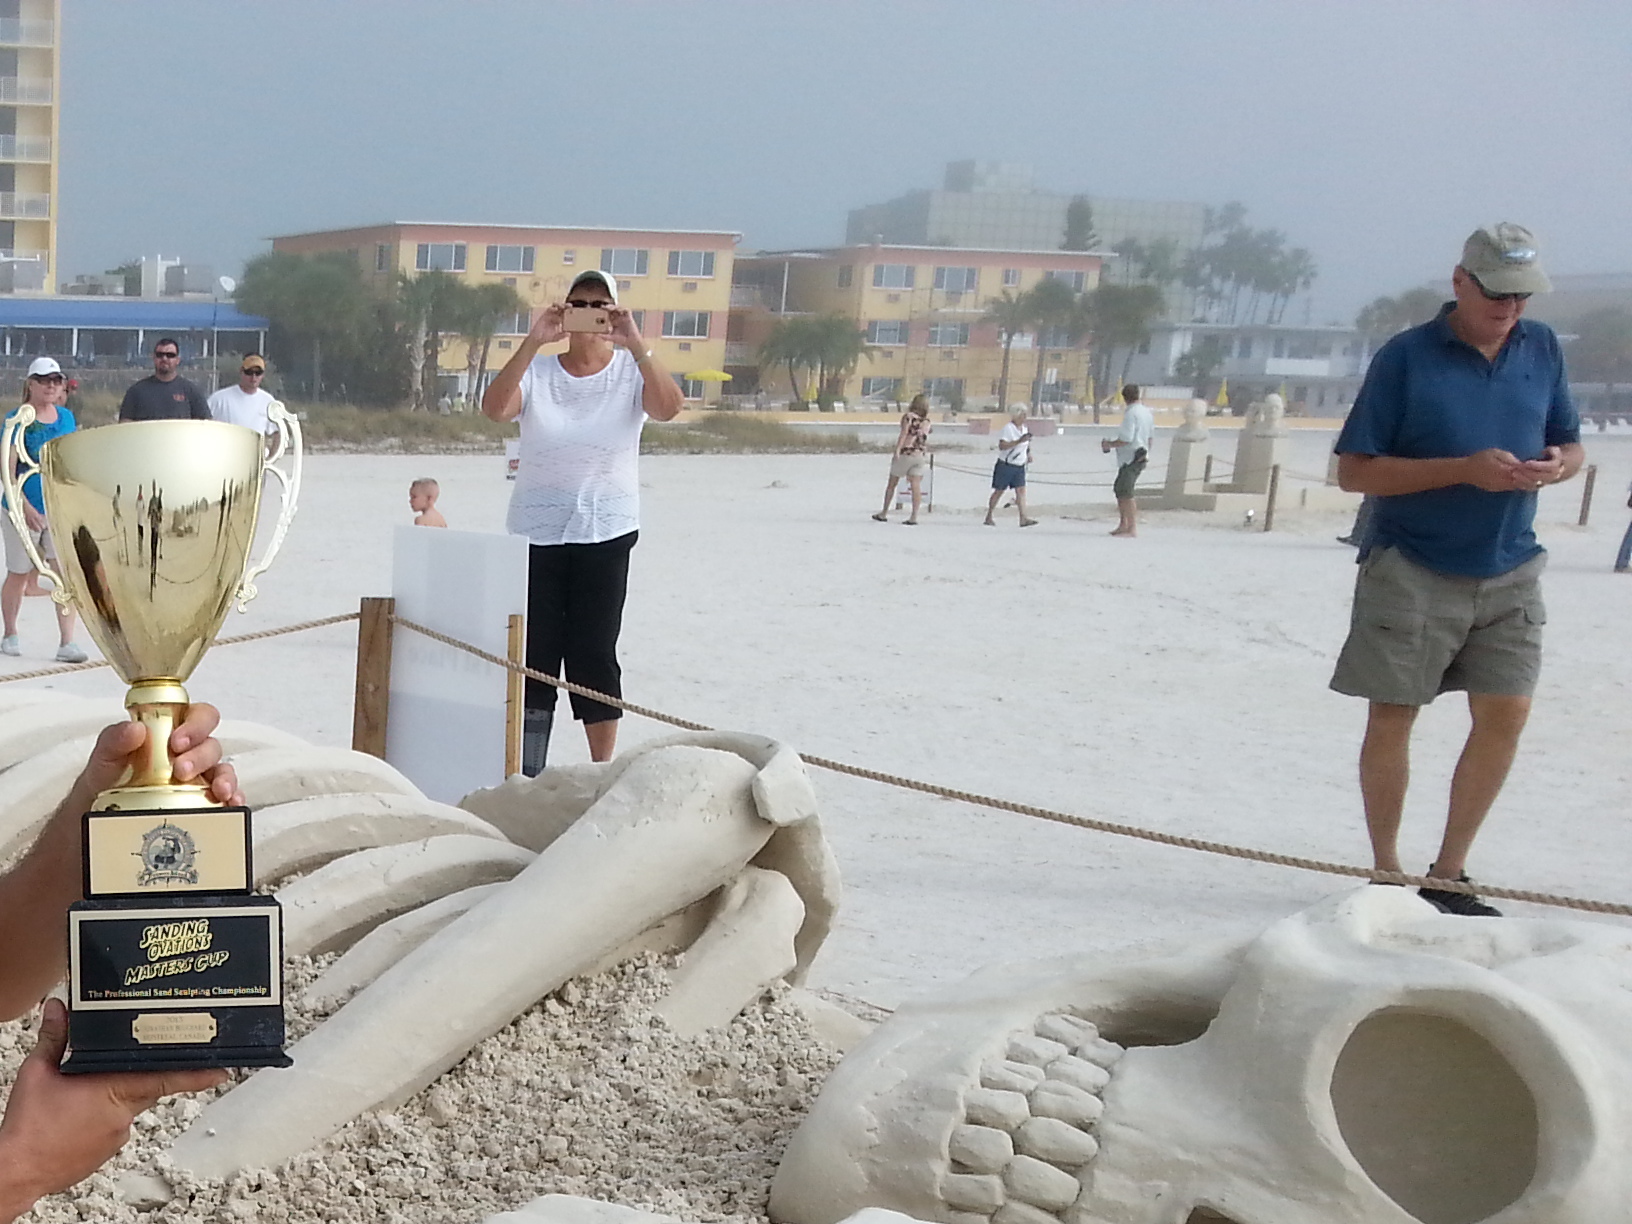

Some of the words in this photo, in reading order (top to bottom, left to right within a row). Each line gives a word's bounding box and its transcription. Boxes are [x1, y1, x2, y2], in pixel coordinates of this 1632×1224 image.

[139, 918, 209, 949] SANDING
[148, 932, 212, 961] OVATIONS
[124, 957, 194, 985] MASTERS
[194, 951, 229, 972] CUP
[88, 990, 103, 998] The
[104, 988, 151, 998] Professional
[153, 987, 172, 997] Sand
[173, 986, 210, 998] Sculpting
[211, 985, 267, 997] Championship
